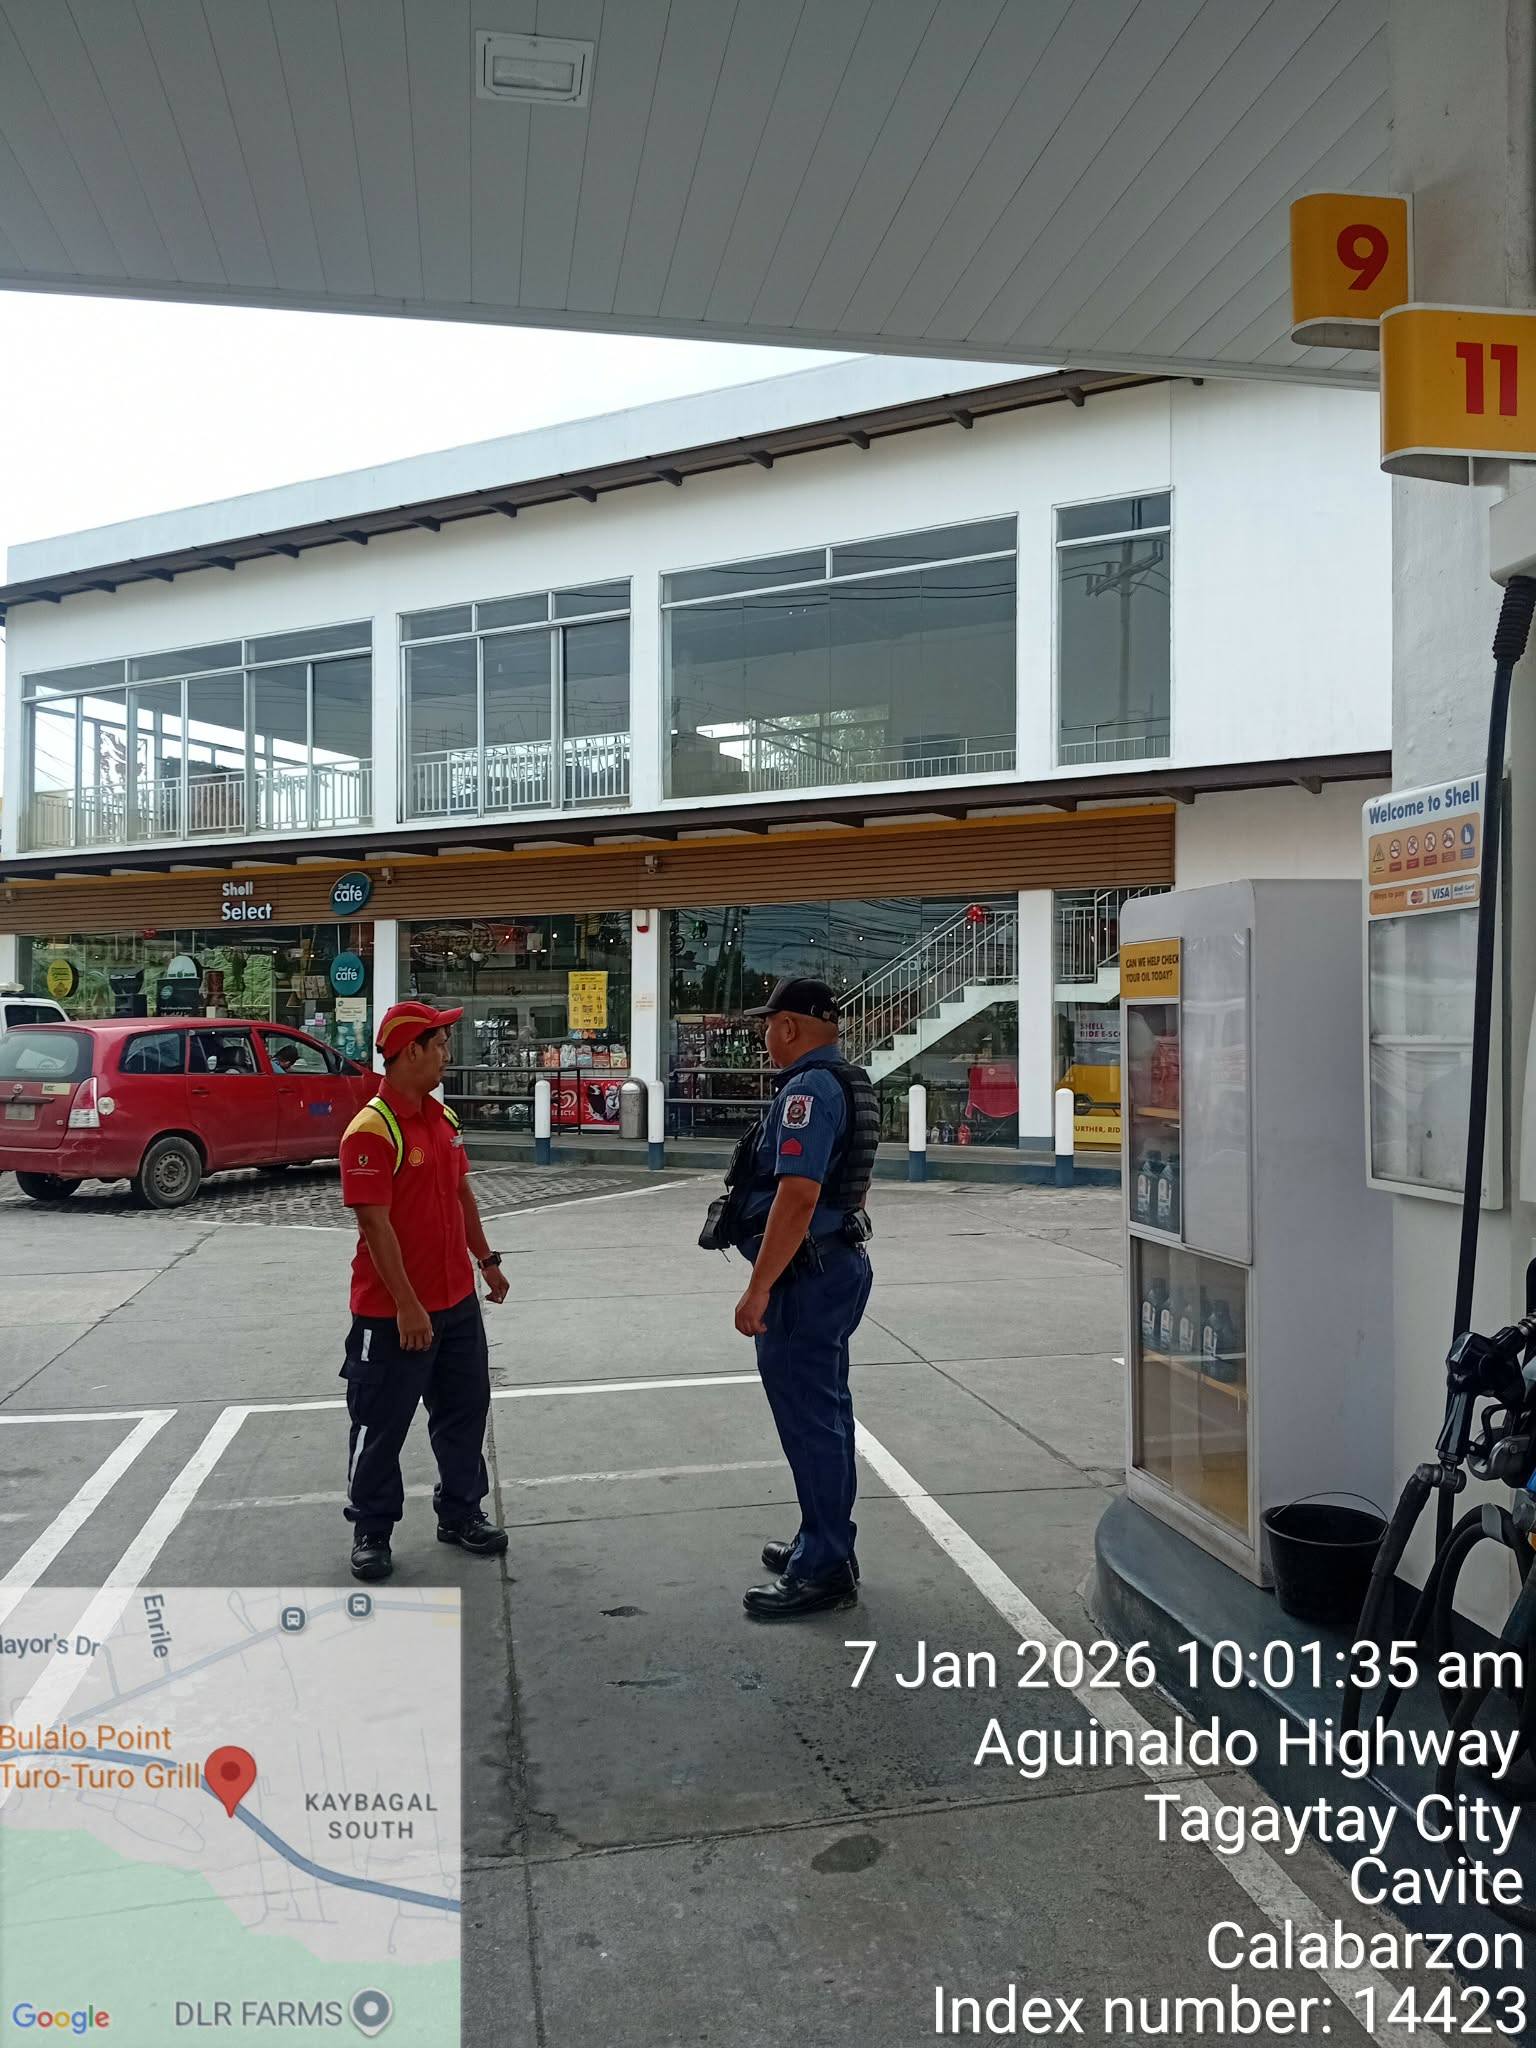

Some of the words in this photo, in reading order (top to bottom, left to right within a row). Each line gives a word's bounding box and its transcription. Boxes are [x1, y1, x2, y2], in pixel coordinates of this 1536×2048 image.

[1336, 223, 1389, 291] 9
[1456, 341, 1518, 417] 11
[1369, 803, 1424, 824] Welcome
[1428, 795, 1440, 812] to
[1445, 780, 1479, 808] Shell
[222, 881, 253, 896] Shell
[334, 885, 363, 902] café
[1432, 887, 1450, 900] VISA
[221, 901, 272, 921] Select
[1126, 958, 1137, 968] CAN
[1138, 957, 1146, 967] WE
[1147, 955, 1161, 966] HELP
[335, 967, 358, 981] café
[1126, 972, 1141, 982] YOUR
[1141, 971, 1150, 982] OIL
[1151, 970, 1172, 981] TODAY?
[1080, 1022, 1104, 1030] SHELL
[1107, 1126, 1121, 1134] RID
